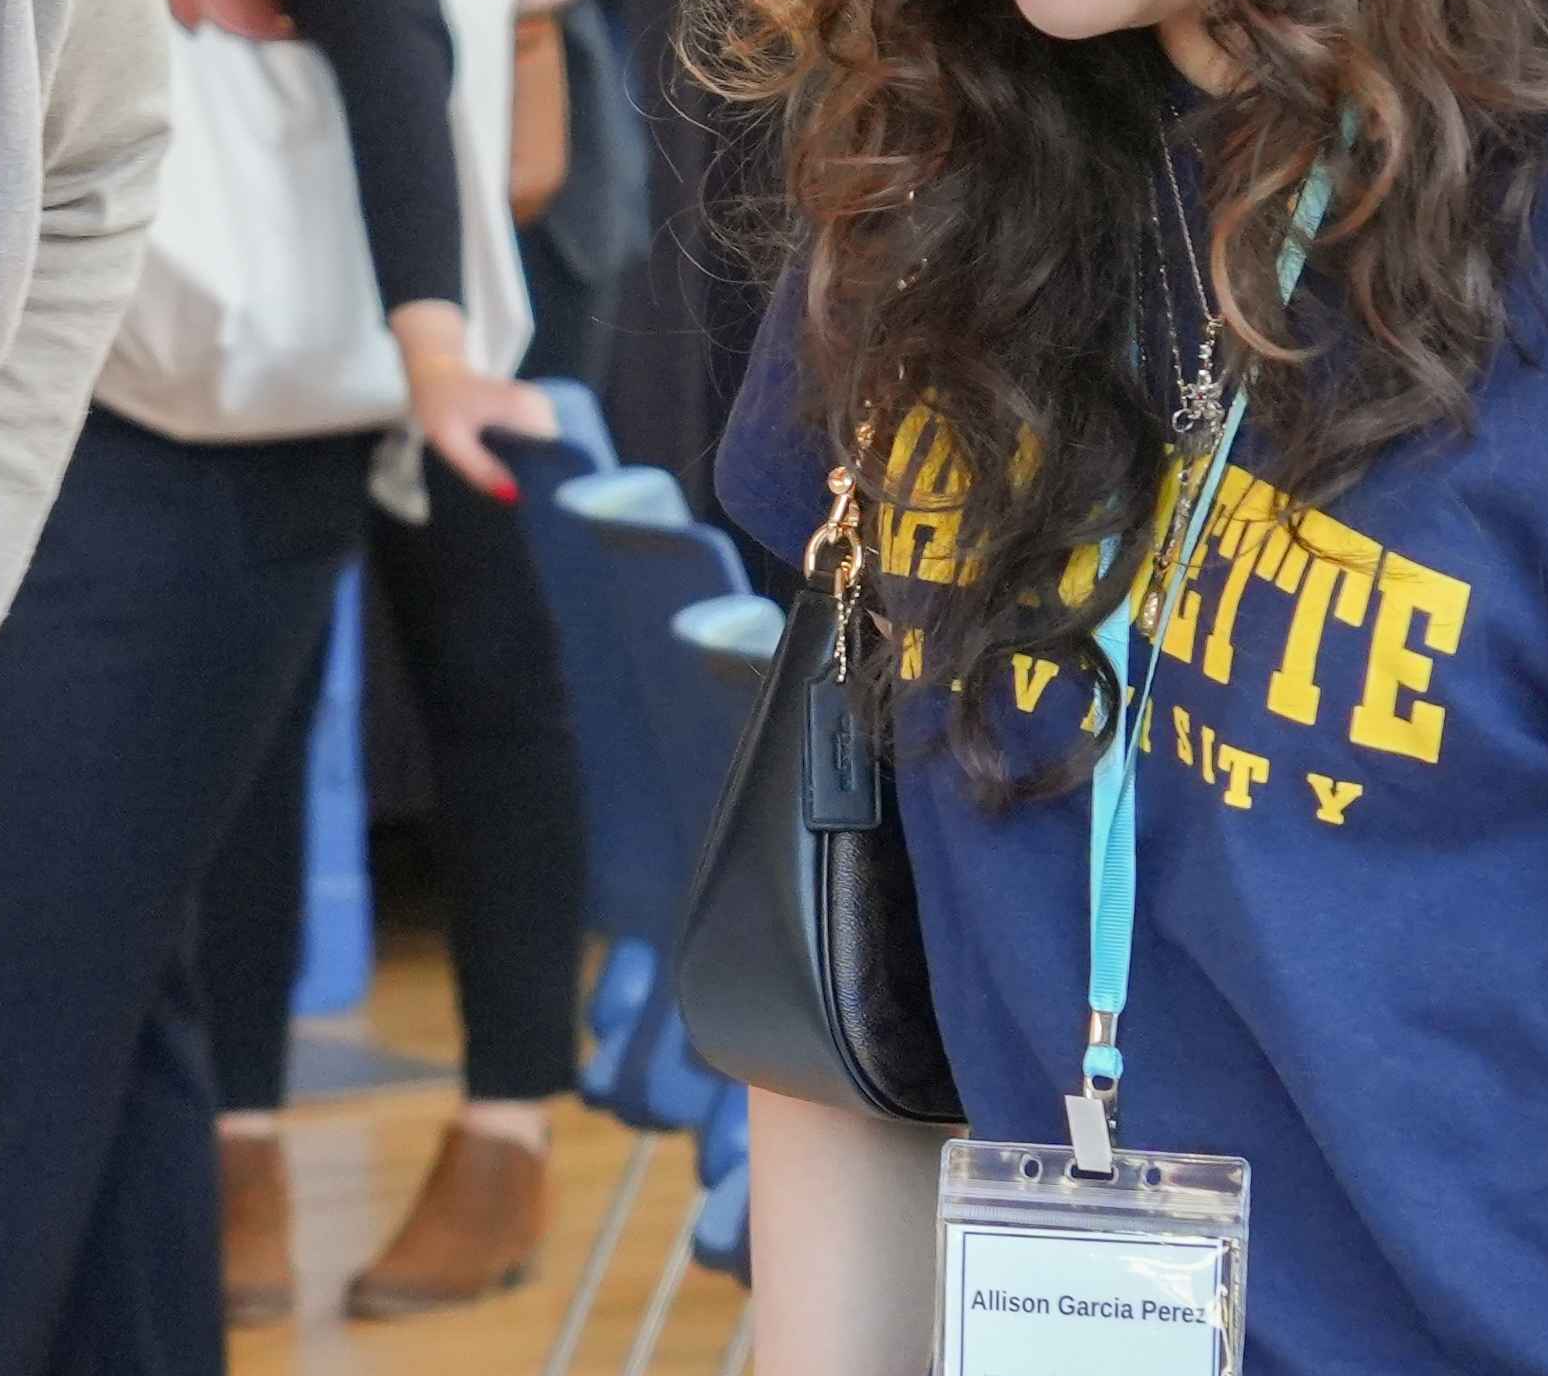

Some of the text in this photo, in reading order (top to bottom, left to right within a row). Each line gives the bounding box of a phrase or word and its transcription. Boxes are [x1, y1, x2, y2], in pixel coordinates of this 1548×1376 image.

[971, 1289, 1206, 1325] Allison Garcia Perez
